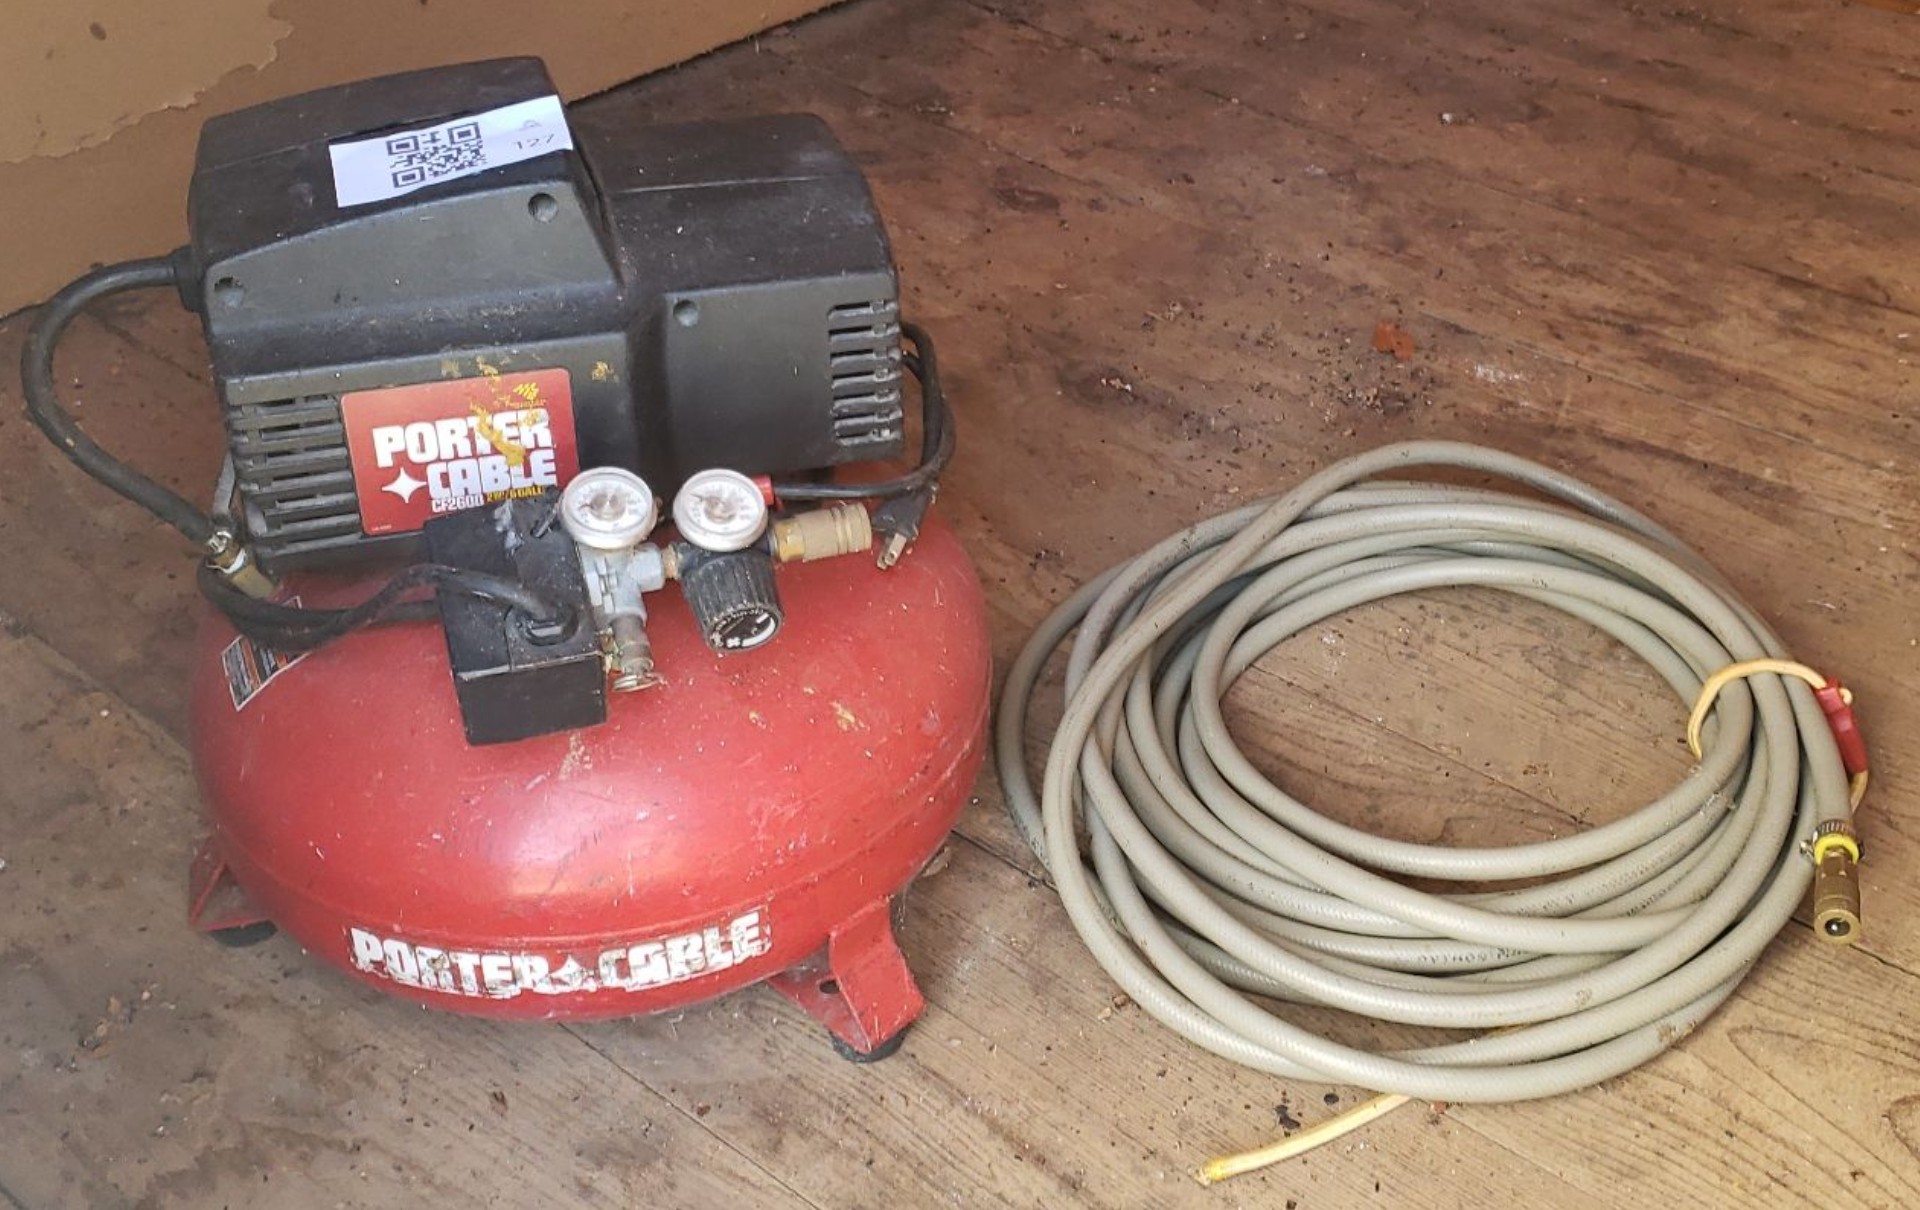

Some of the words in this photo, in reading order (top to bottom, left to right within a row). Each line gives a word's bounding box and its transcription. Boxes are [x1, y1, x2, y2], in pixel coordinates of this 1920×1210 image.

[372, 408, 553, 468] PORTER
[426, 449, 557, 500] CABLE
[350, 927, 550, 998] PORTER
